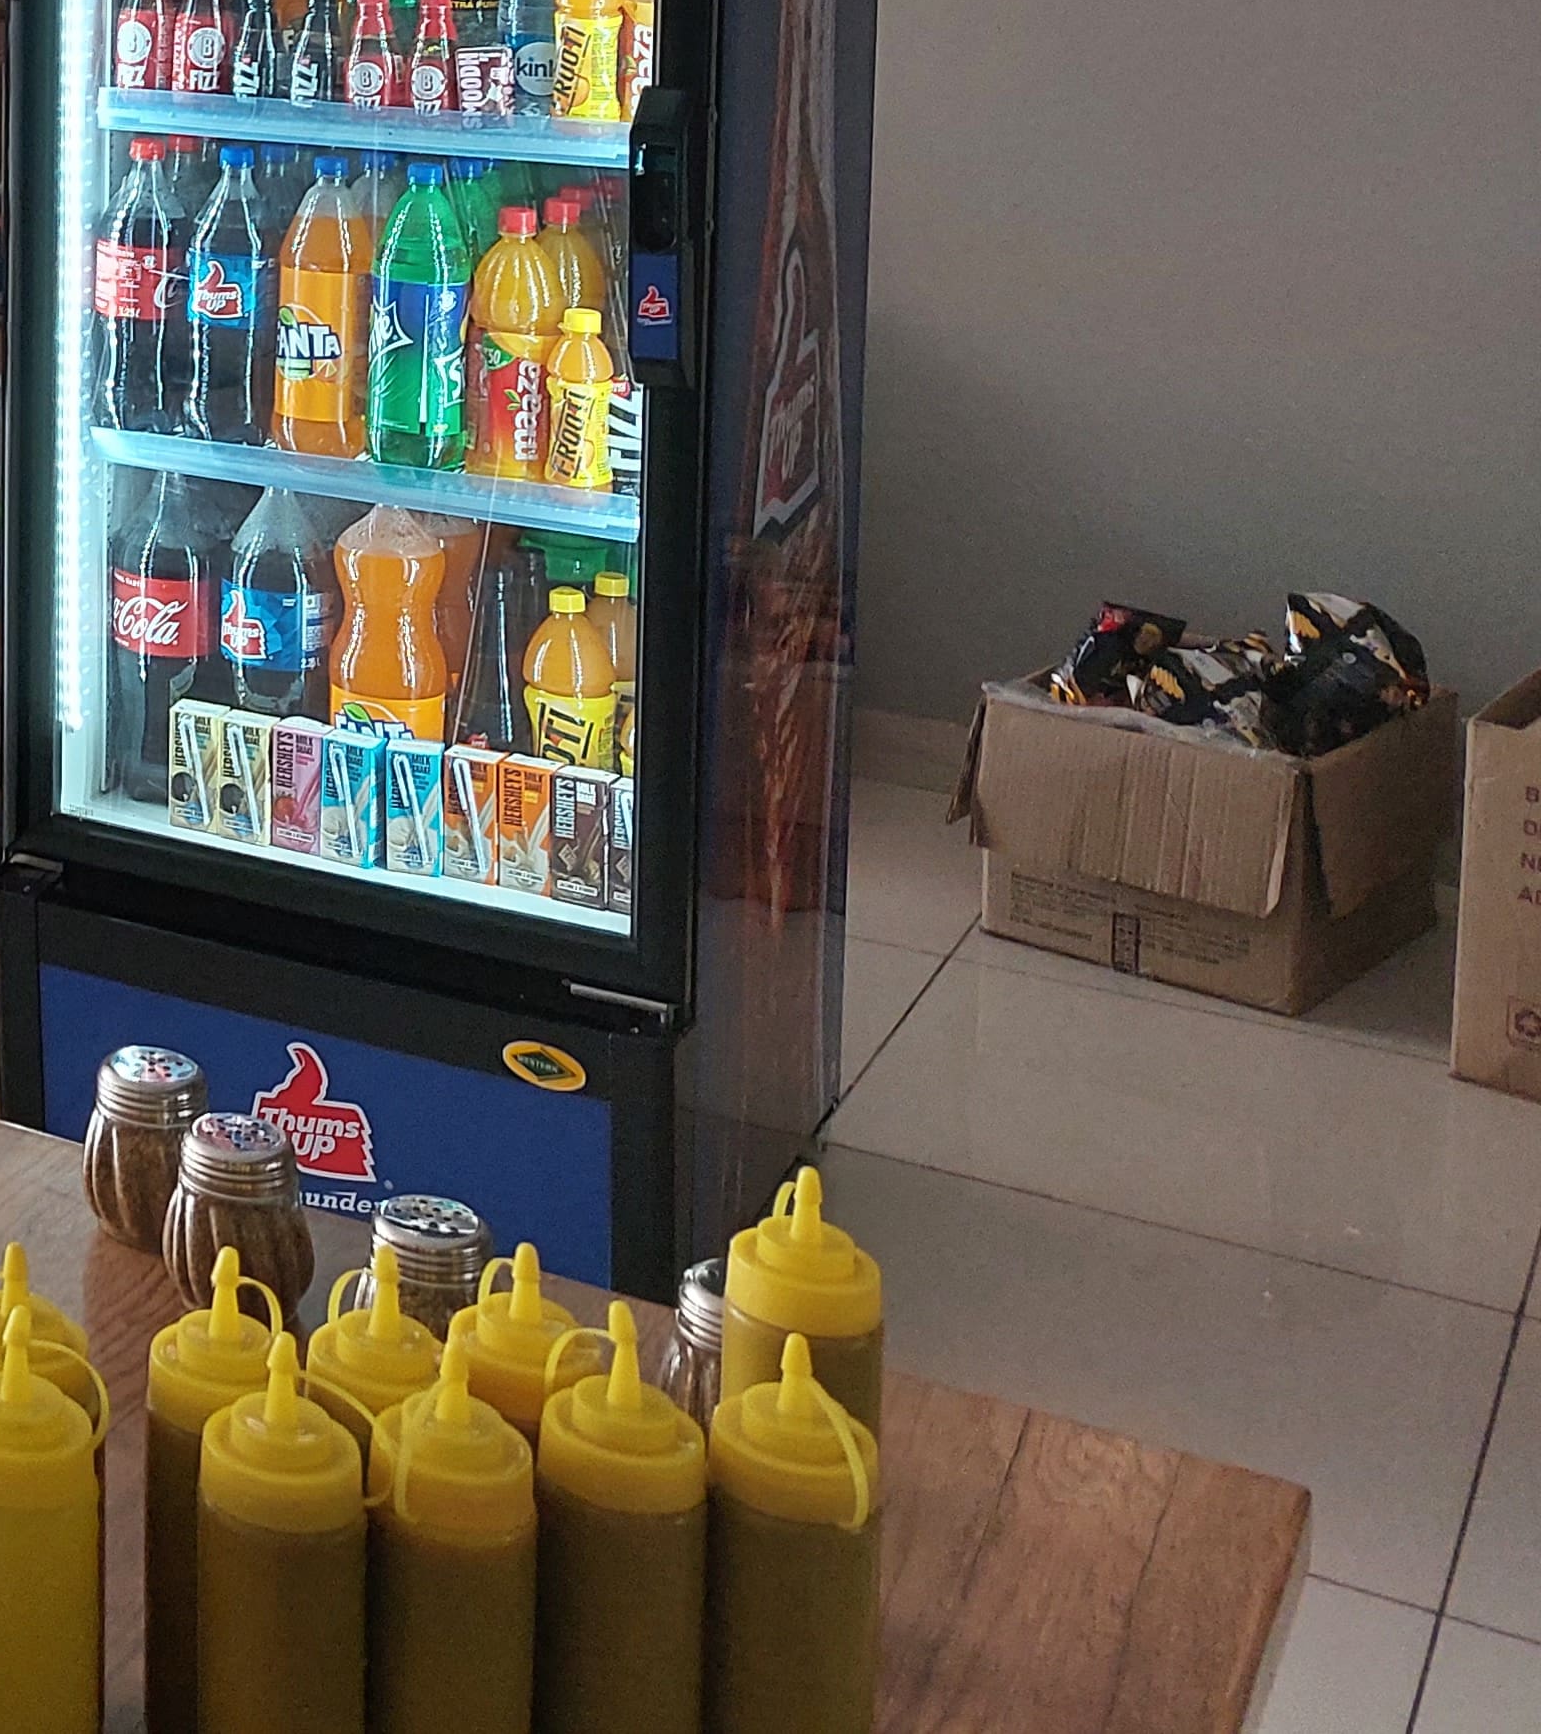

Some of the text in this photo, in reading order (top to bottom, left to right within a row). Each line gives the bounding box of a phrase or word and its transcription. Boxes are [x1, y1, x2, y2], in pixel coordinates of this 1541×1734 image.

[459, 51, 482, 129] SMOODH
[516, 57, 555, 78] kinl
[277, 323, 343, 359] ANTA
[514, 360, 543, 461] maaza
[551, 386, 593, 477] FROOTI
[118, 596, 189, 646] Cola
[277, 730, 294, 790] HERSHEY'S
[503, 767, 523, 828] HERSHEY'S
[554, 776, 576, 840] HERSHEY'S
[259, 1106, 362, 1141] Thums
[292, 1133, 336, 1162] UP
[299, 1190, 383, 1215] under
